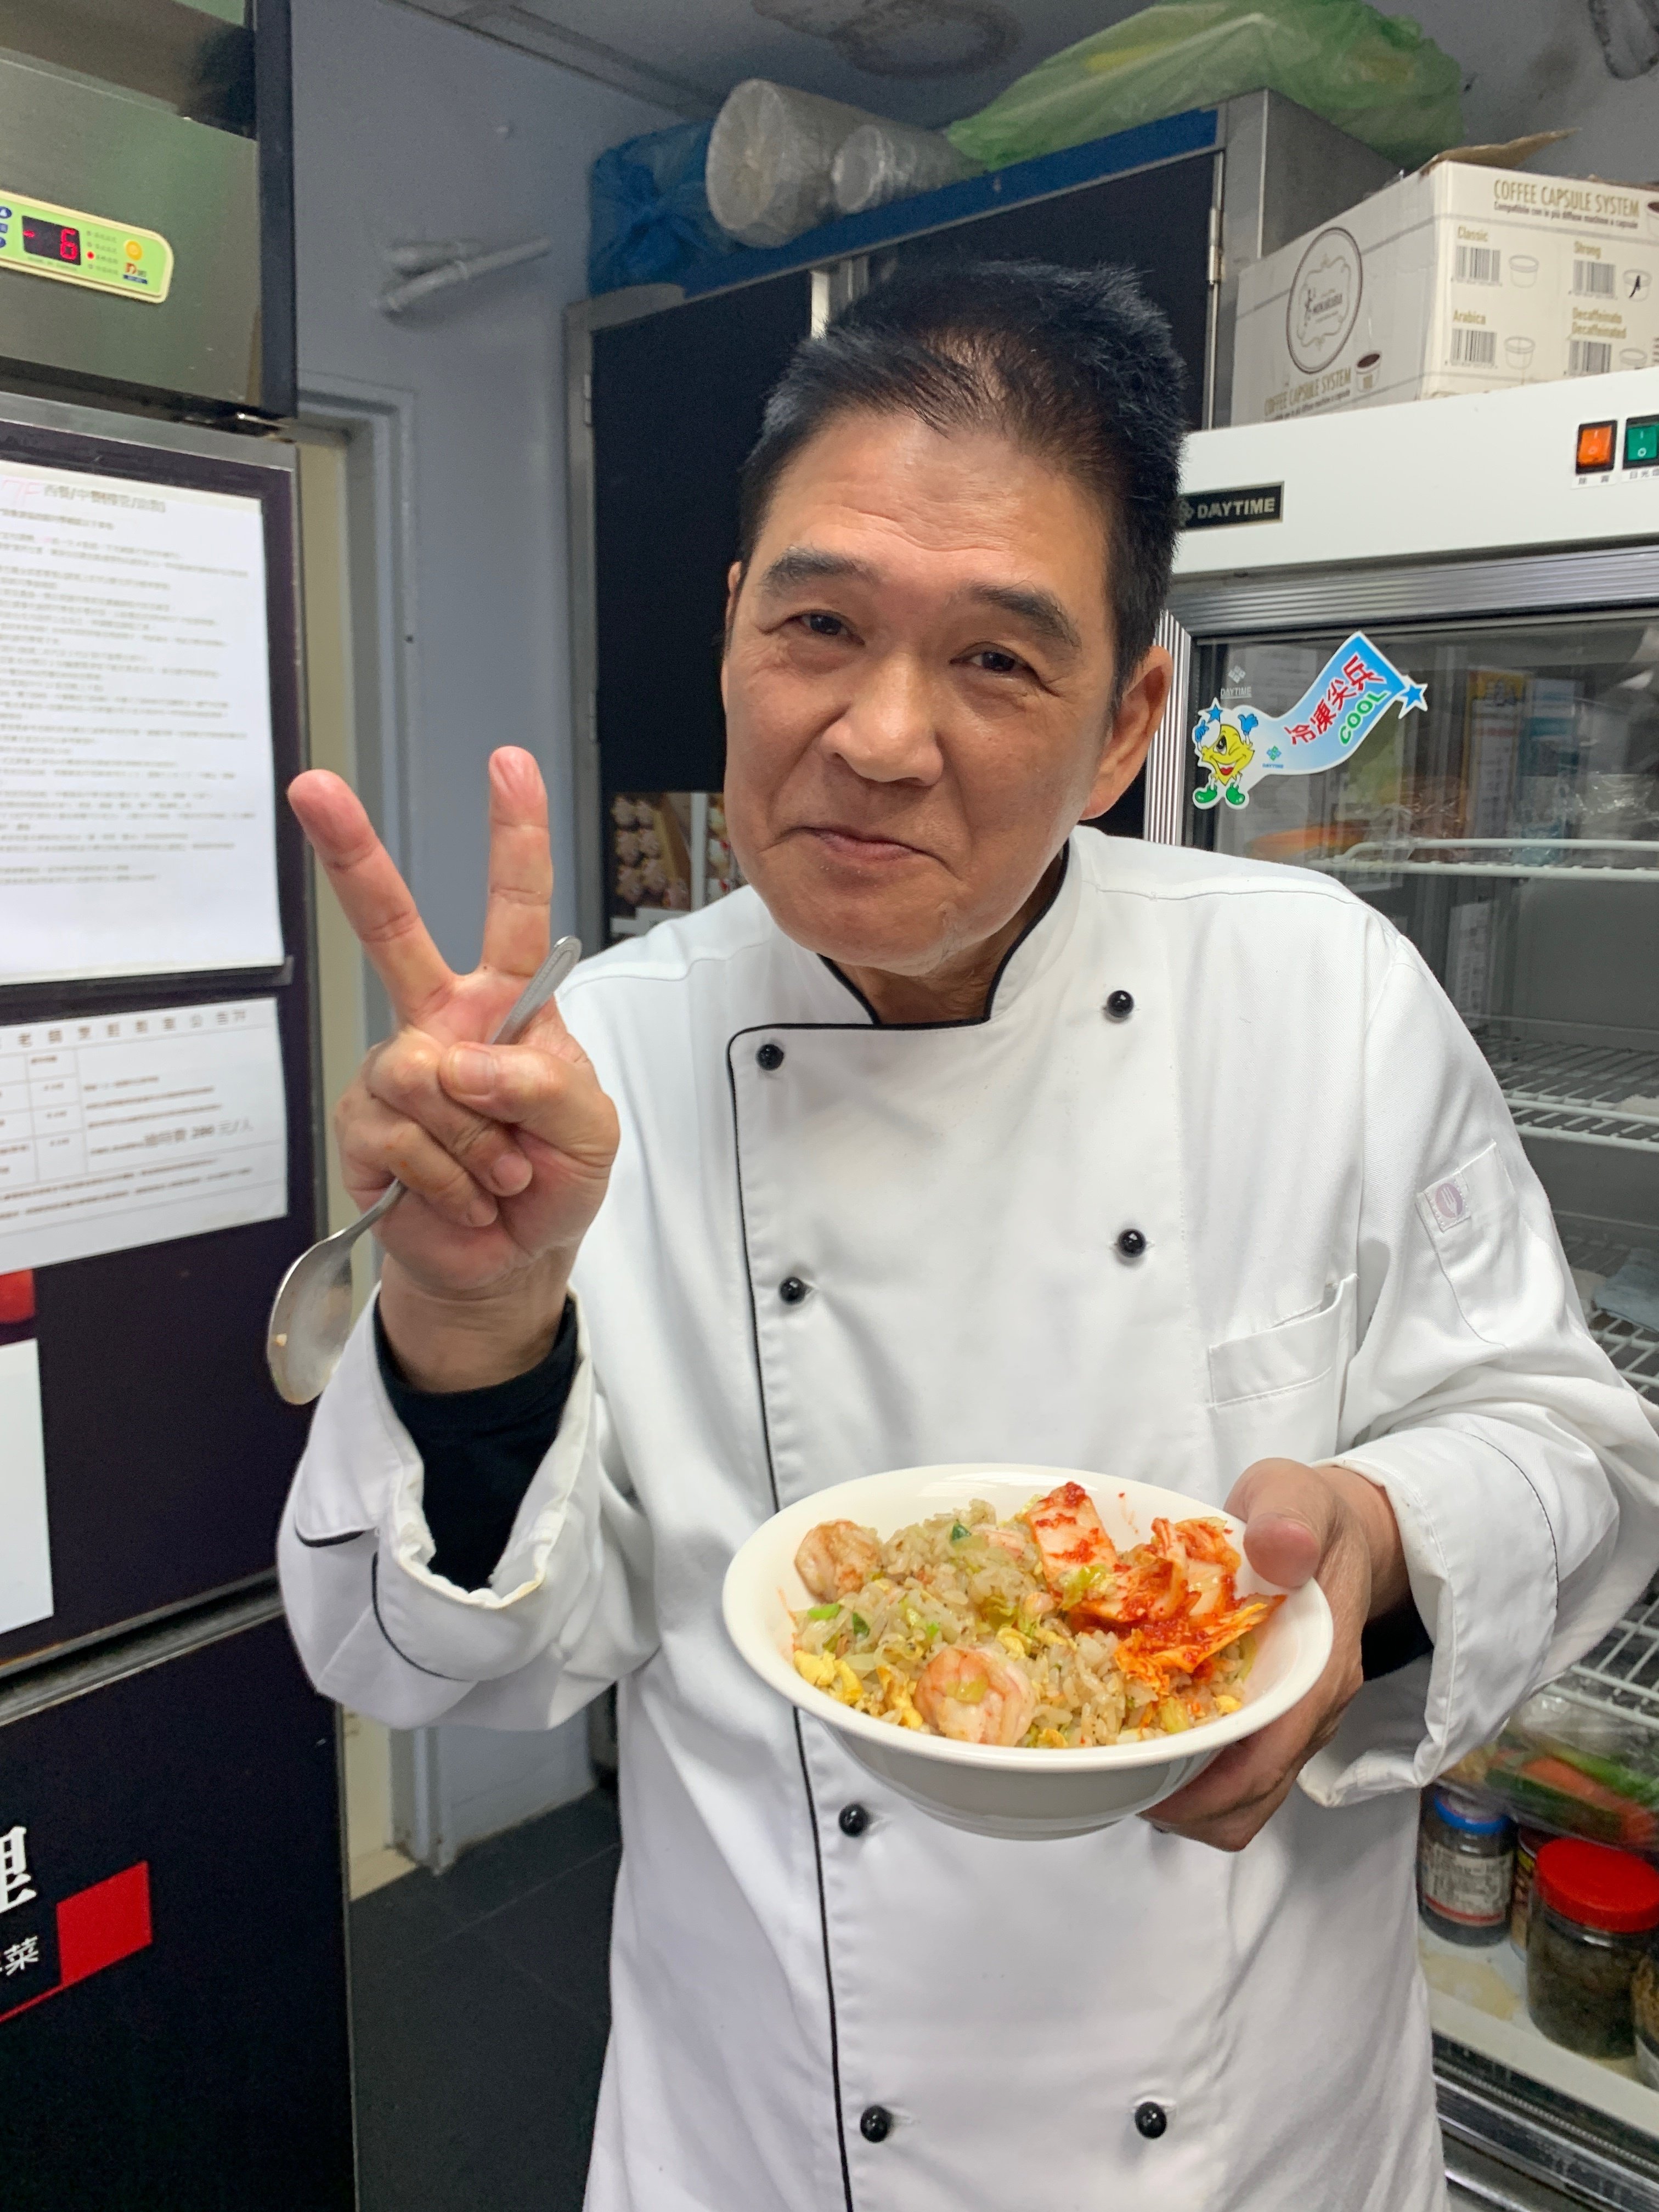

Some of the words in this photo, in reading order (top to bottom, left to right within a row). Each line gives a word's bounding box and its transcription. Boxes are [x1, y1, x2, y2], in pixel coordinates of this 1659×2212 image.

[1493, 179, 1536, 204] COFFEE
[1541, 186, 1592, 212] CAPSULE
[1595, 194, 1640, 218] SYSTEM
[1457, 225, 1488, 242] Classic
[1574, 240, 1601, 259] Strong
[1453, 309, 1486, 325] Arabica
[1322, 366, 1351, 394] SYSTEM
[1197, 496, 1275, 519] DAYTIME
[1220, 686, 1252, 697] DAYTIME
[1284, 654, 1387, 746] 冷凍尖兵
[1339, 691, 1390, 745] COOL
[0, 1935, 39, 1976] 菜
